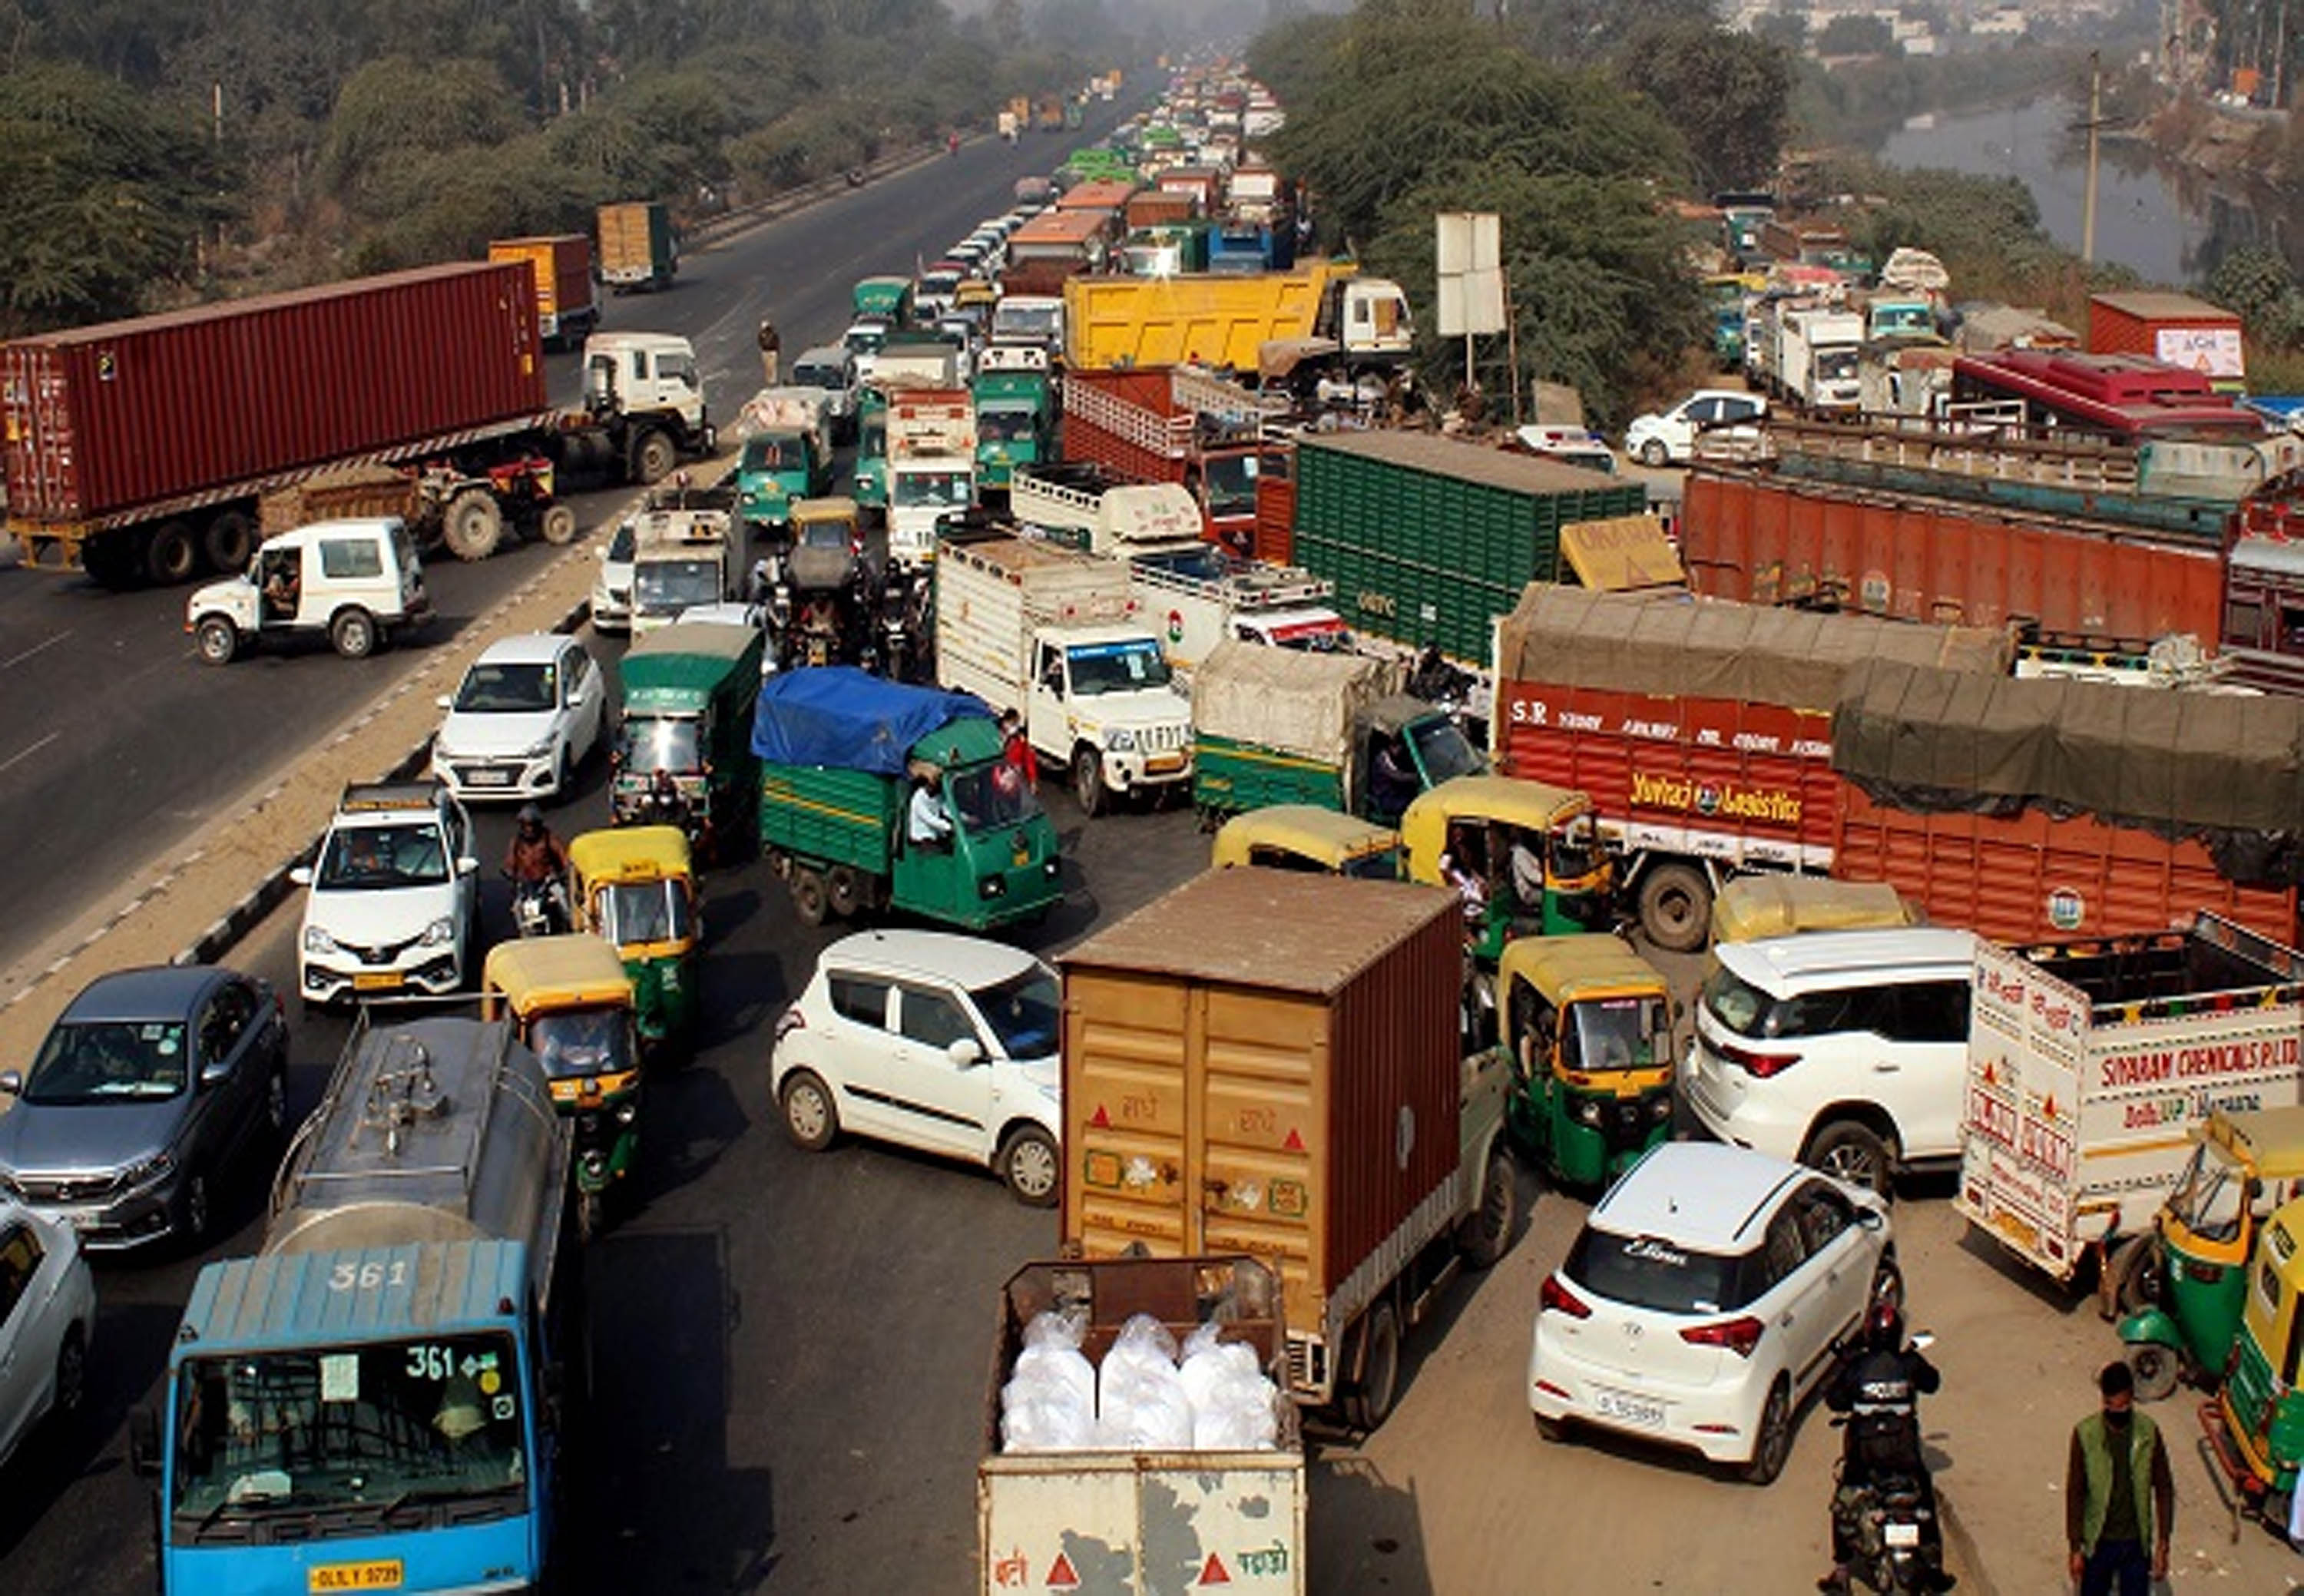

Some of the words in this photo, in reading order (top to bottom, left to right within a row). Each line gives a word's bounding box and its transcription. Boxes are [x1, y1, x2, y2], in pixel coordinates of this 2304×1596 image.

[1722, 785, 1802, 824] Logistics
[2101, 1052, 2173, 1087] SIYARAM
[2177, 1041, 2258, 1078] CHEMICALS
[328, 1261, 406, 1291] 361
[406, 1345, 455, 1381] 361
